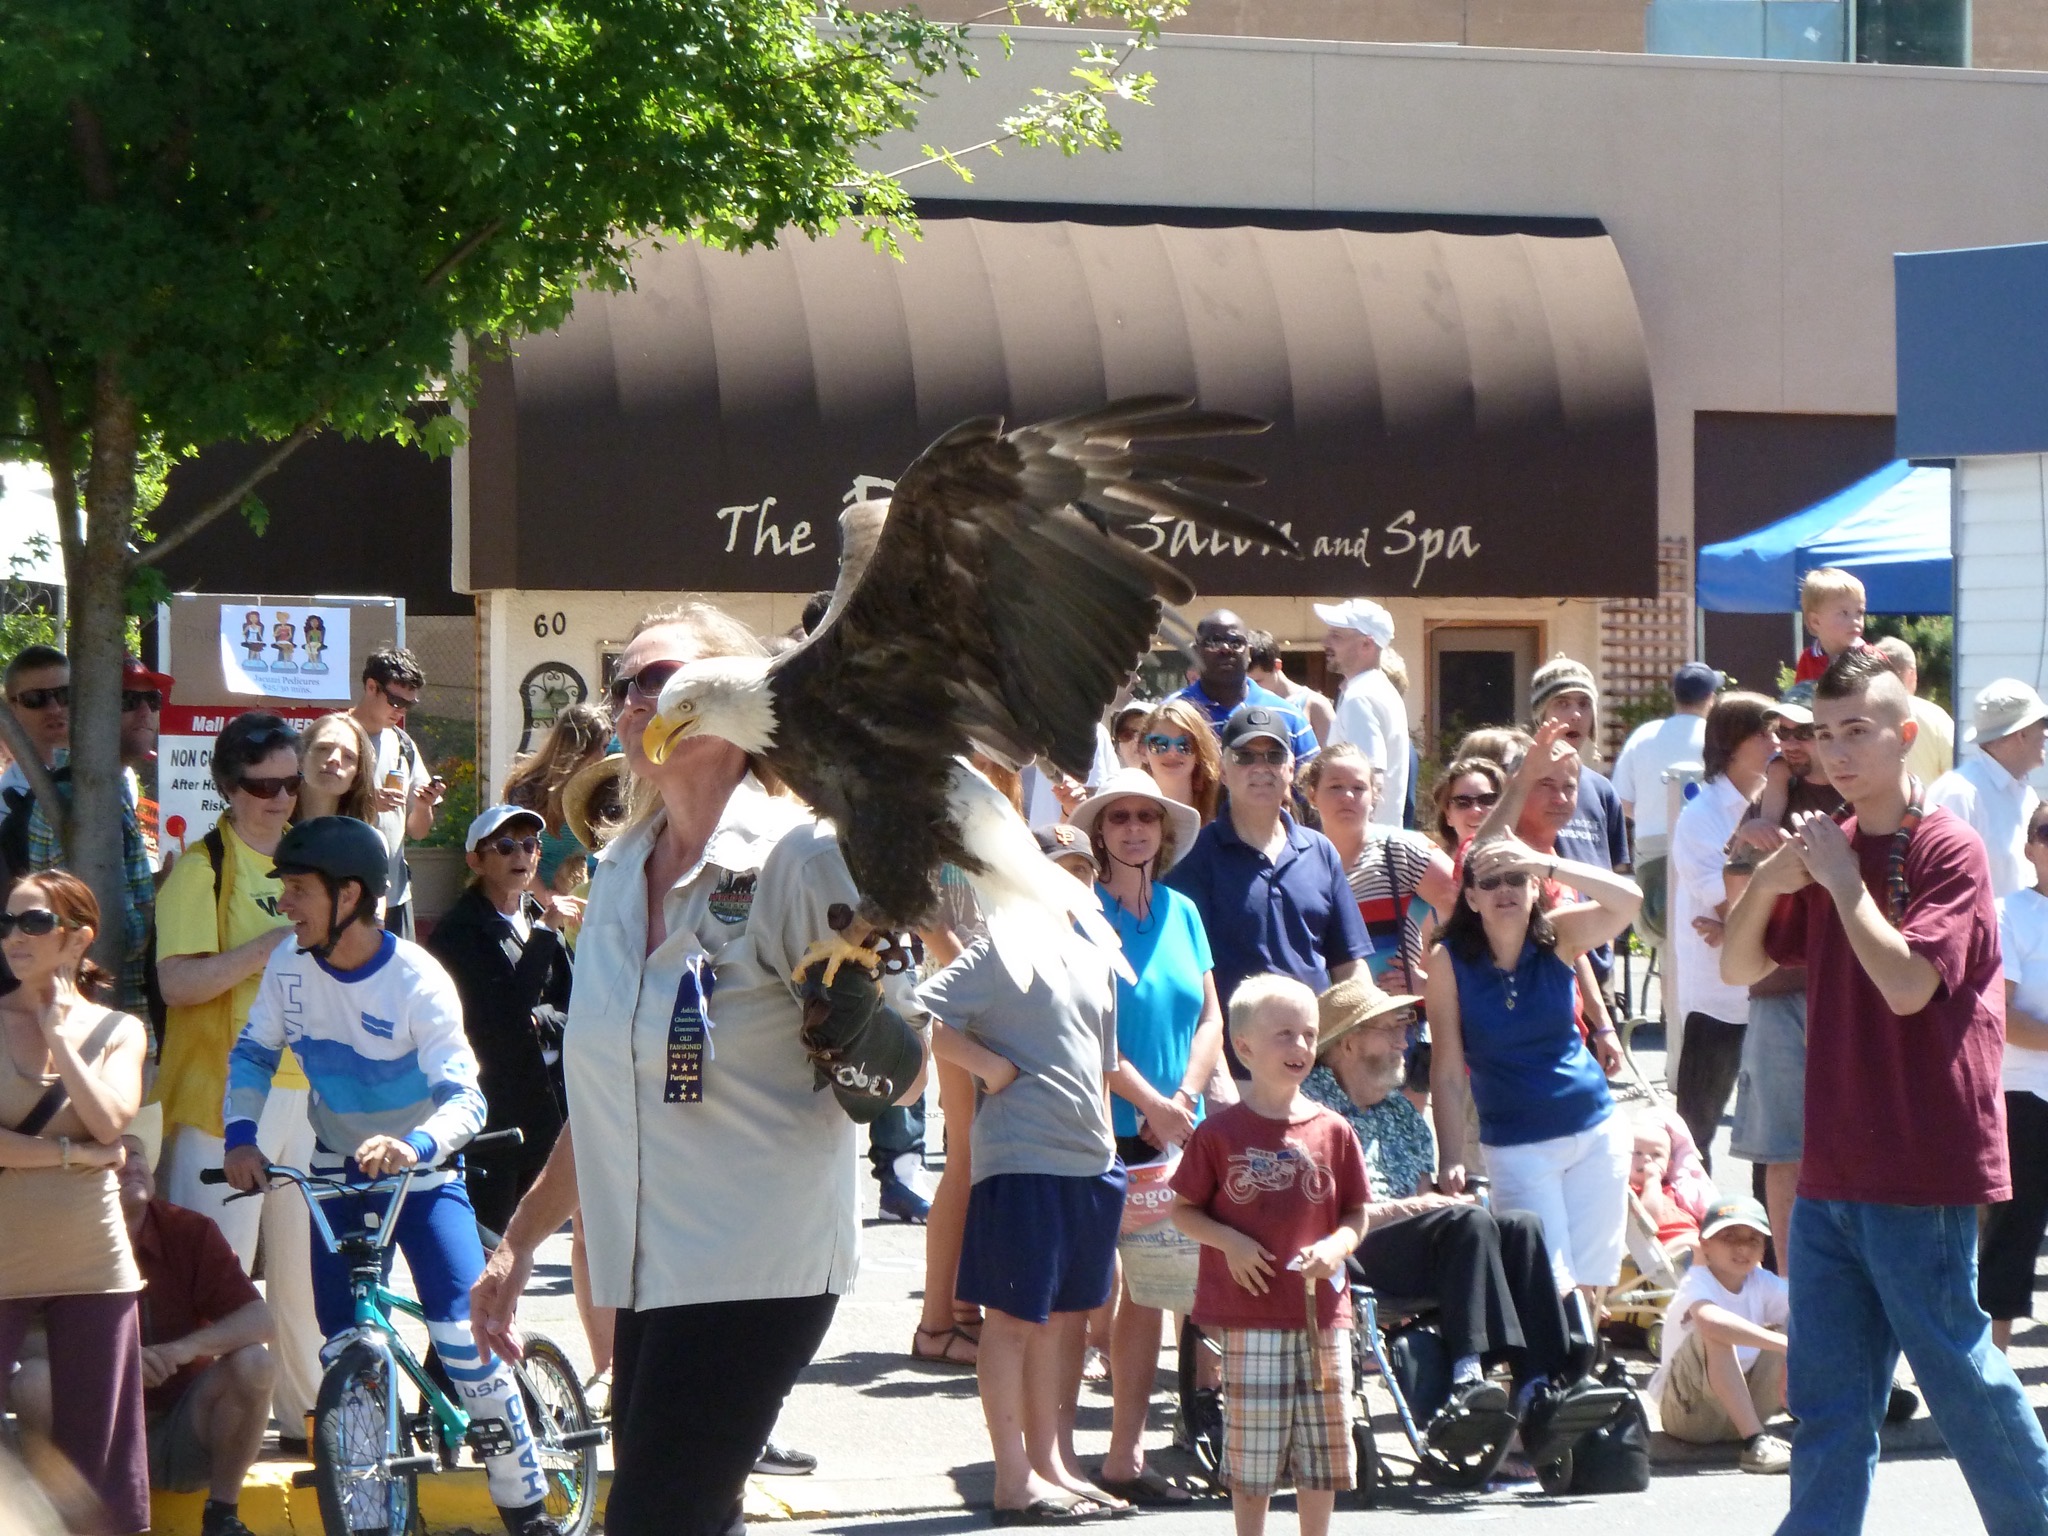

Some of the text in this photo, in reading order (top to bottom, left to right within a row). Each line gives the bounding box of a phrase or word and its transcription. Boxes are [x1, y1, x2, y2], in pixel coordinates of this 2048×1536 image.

[716, 496, 816, 556] The
[1313, 528, 1371, 567] and
[1383, 510, 1482, 589] Spa
[534, 611, 567, 638] 60
[281, 676, 320, 686] Pedicures
[191, 716, 224, 732] Mall
[170, 749, 196, 767] NON
[171, 778, 200, 790] After
[201, 799, 226, 812] Risk
[669, 1043, 702, 1051] FASHIONED
[463, 1378, 508, 1398] USA
[505, 1393, 542, 1500] HARO
